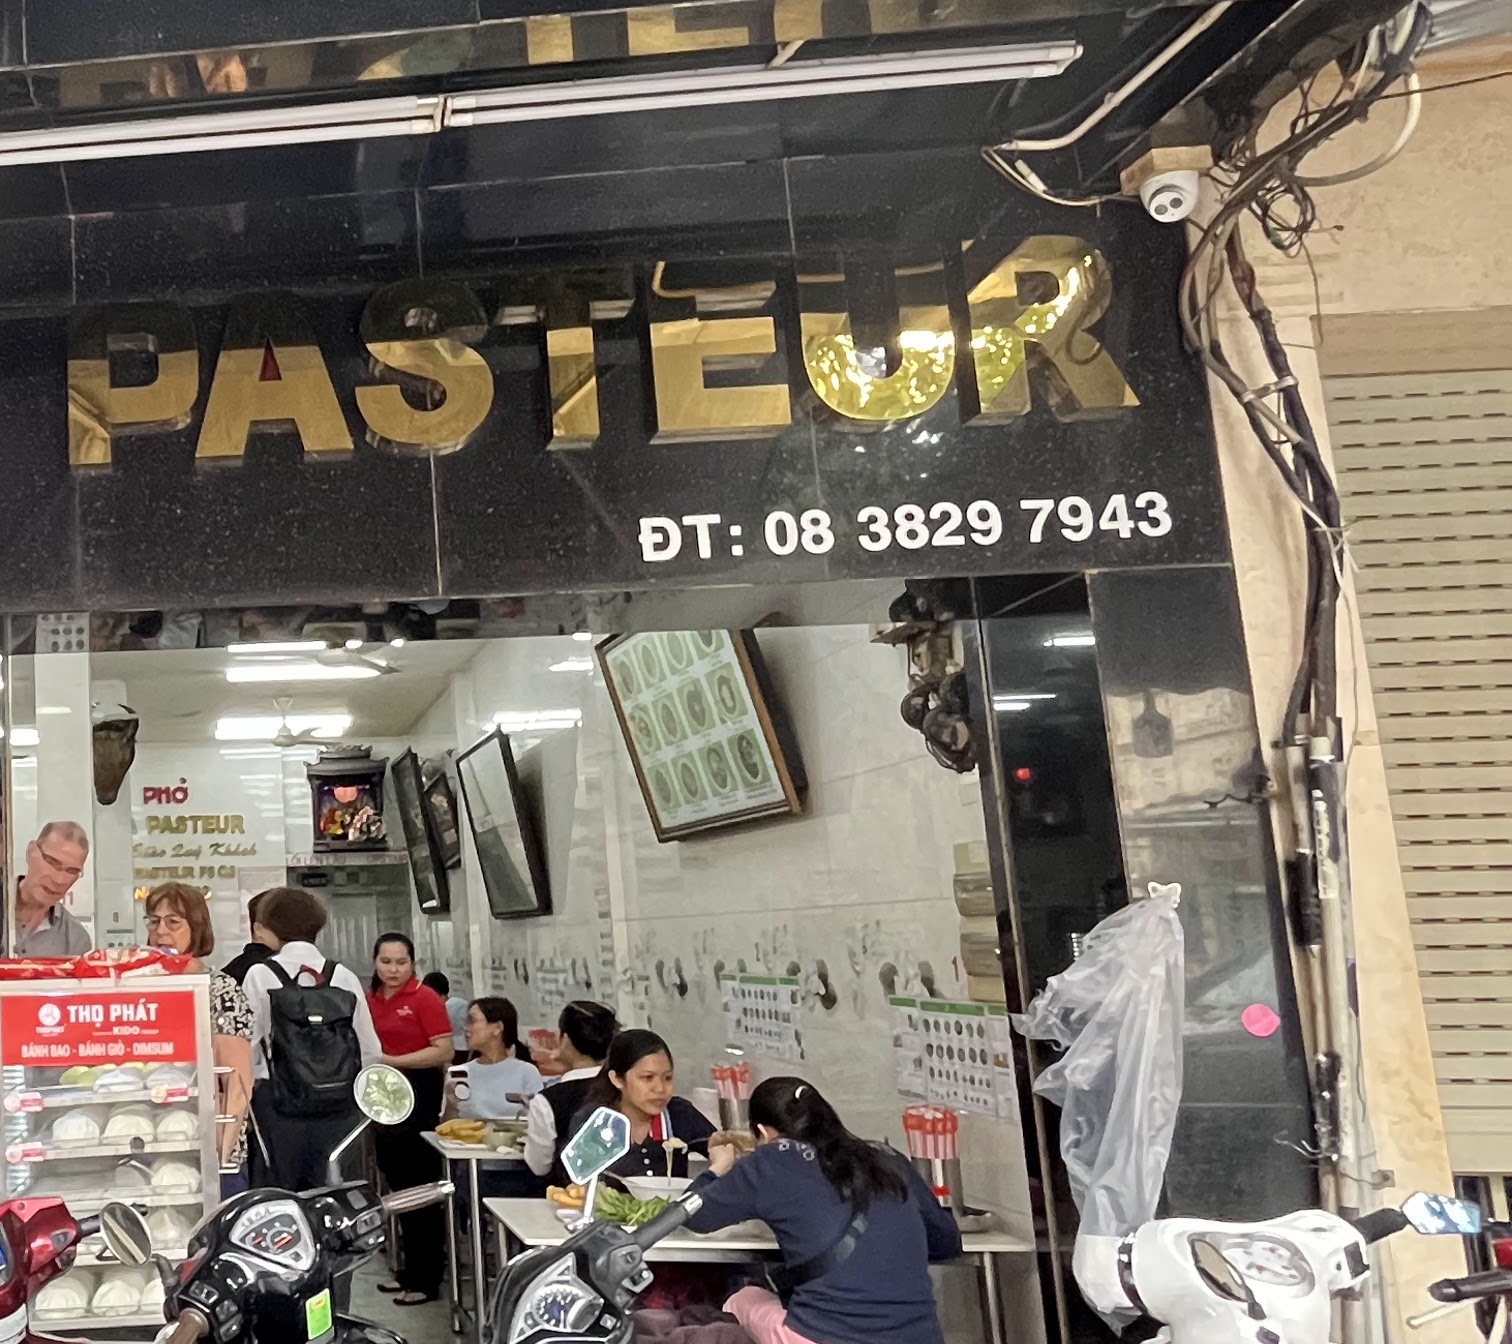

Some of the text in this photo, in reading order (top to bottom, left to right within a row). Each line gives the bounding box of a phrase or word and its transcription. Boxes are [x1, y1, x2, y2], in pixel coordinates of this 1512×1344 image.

[68, 234, 1141, 474] PASTEUR
[638, 491, 1174, 563] ĐT: 08 3829 7943
[146, 814, 246, 835] PASTEUR
[67, 997, 159, 1028] THỌ PHÁT
[112, 1025, 141, 1036] KIDO
